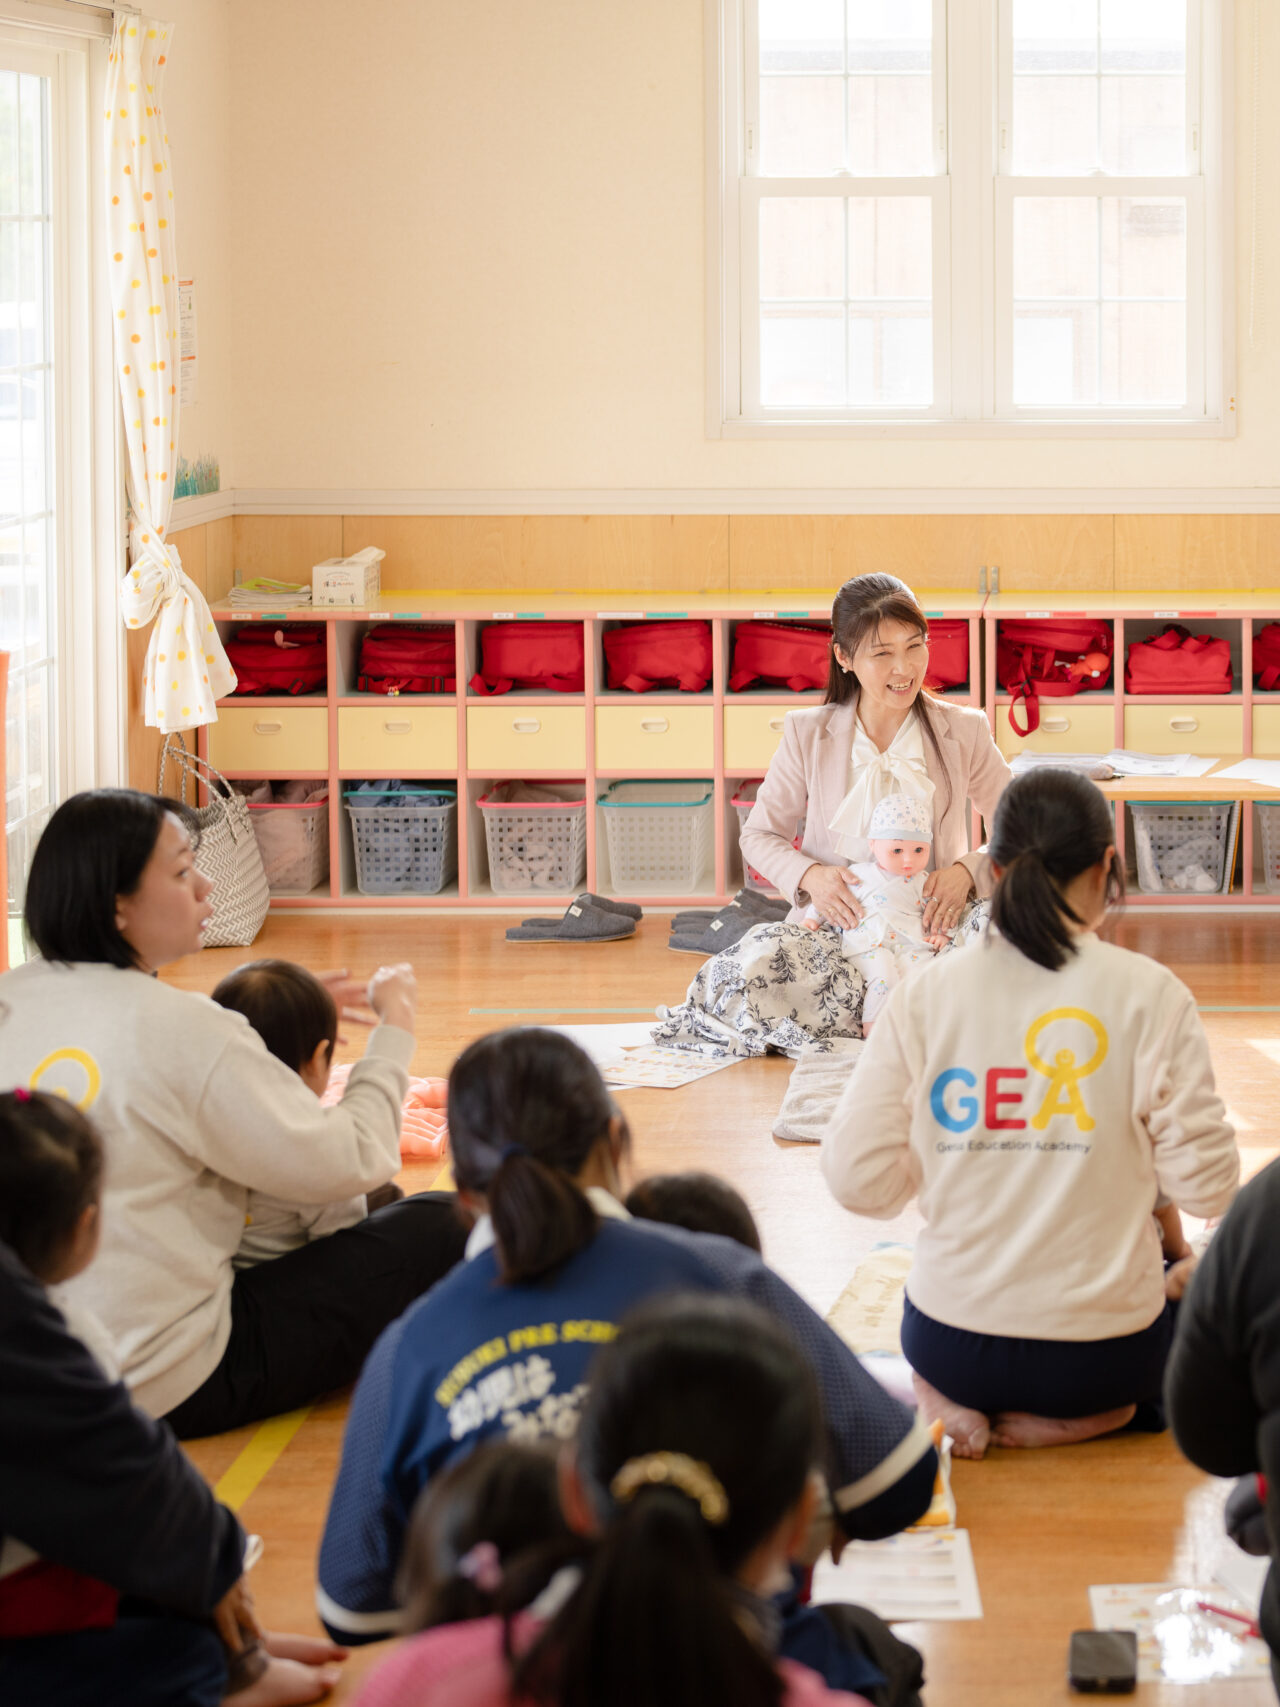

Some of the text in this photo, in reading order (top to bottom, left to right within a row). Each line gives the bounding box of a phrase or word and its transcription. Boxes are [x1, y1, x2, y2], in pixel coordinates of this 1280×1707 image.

[930, 1007, 1109, 1133] GEA
[968, 1139, 1031, 1152] Education
[1034, 1140, 1092, 1154] Academy
